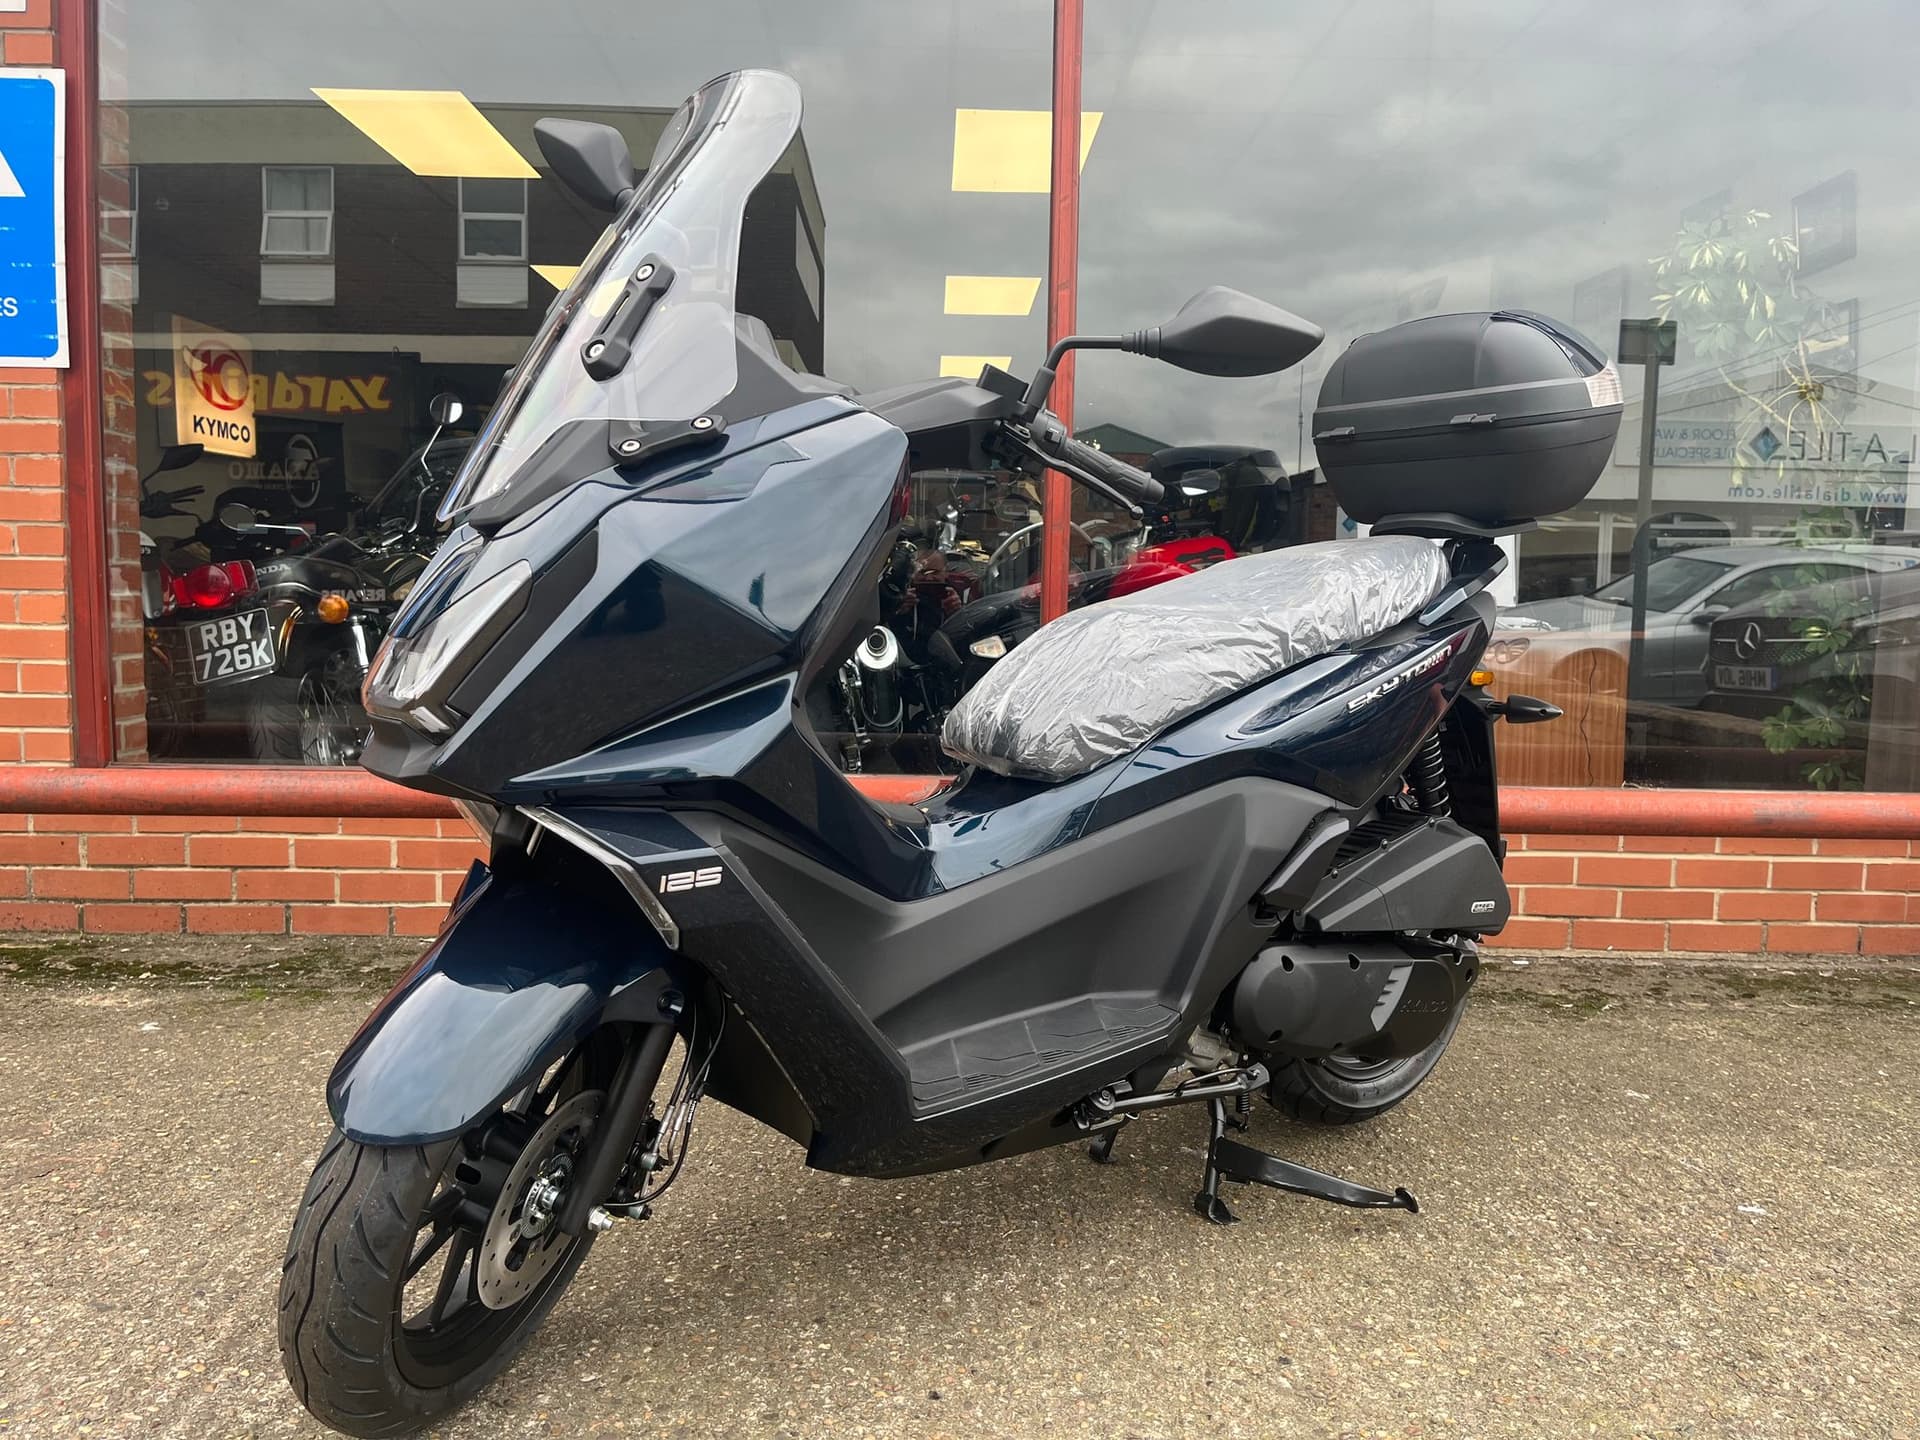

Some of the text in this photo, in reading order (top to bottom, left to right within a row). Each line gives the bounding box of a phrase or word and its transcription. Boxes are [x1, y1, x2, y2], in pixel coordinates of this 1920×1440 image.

[193, 415, 250, 443] KYMCO
[200, 613, 254, 650] RBY
[195, 638, 270, 680] 726K
[659, 866, 723, 893] 125
